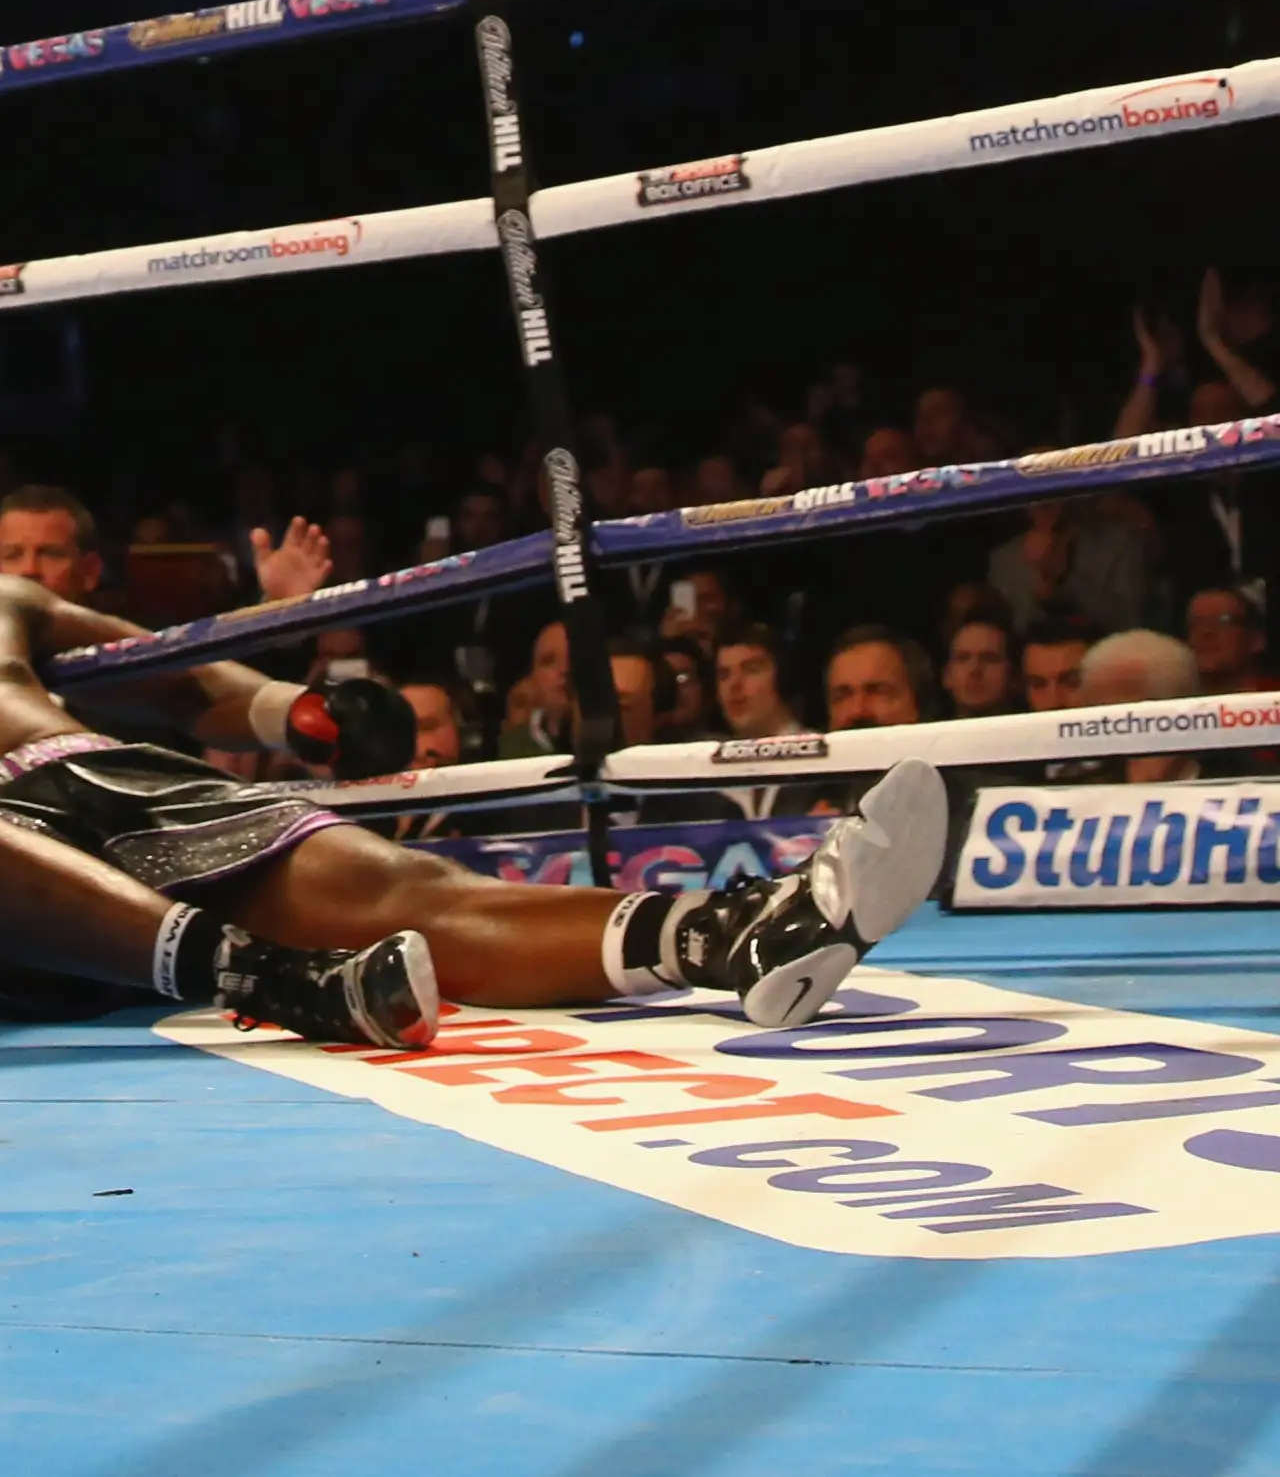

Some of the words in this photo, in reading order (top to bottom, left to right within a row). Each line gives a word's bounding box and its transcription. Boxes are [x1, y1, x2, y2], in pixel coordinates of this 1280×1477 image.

[8, 28, 106, 70] VEGAS
[493, 114, 523, 172] HILL
[970, 97, 1220, 152] matchroomboxing
[148, 231, 350, 274] matchroomboxing
[521, 308, 552, 365] HILL
[555, 543, 588, 604] HILL
